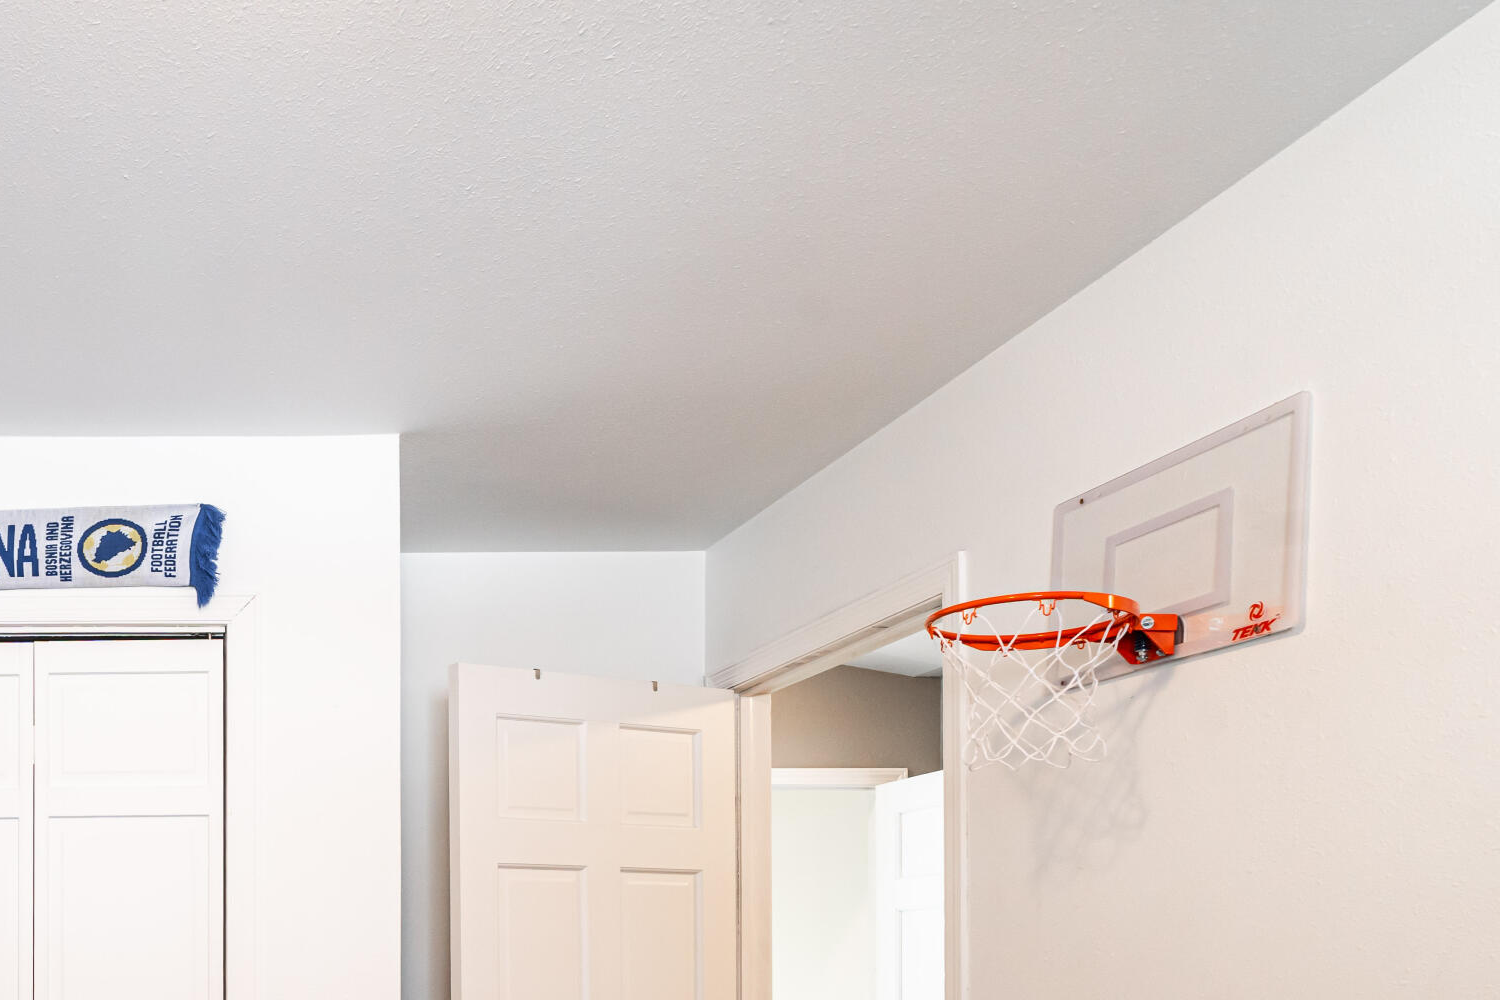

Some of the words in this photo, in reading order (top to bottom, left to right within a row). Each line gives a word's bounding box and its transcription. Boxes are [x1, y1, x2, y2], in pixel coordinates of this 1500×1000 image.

[46, 521, 60, 541] AND
[60, 515, 75, 582] HERZEGOVINA
[151, 520, 168, 573] FOOTBALL
[164, 514, 184, 578] FEDERATION
[45, 544, 59, 577] BOSNIA
